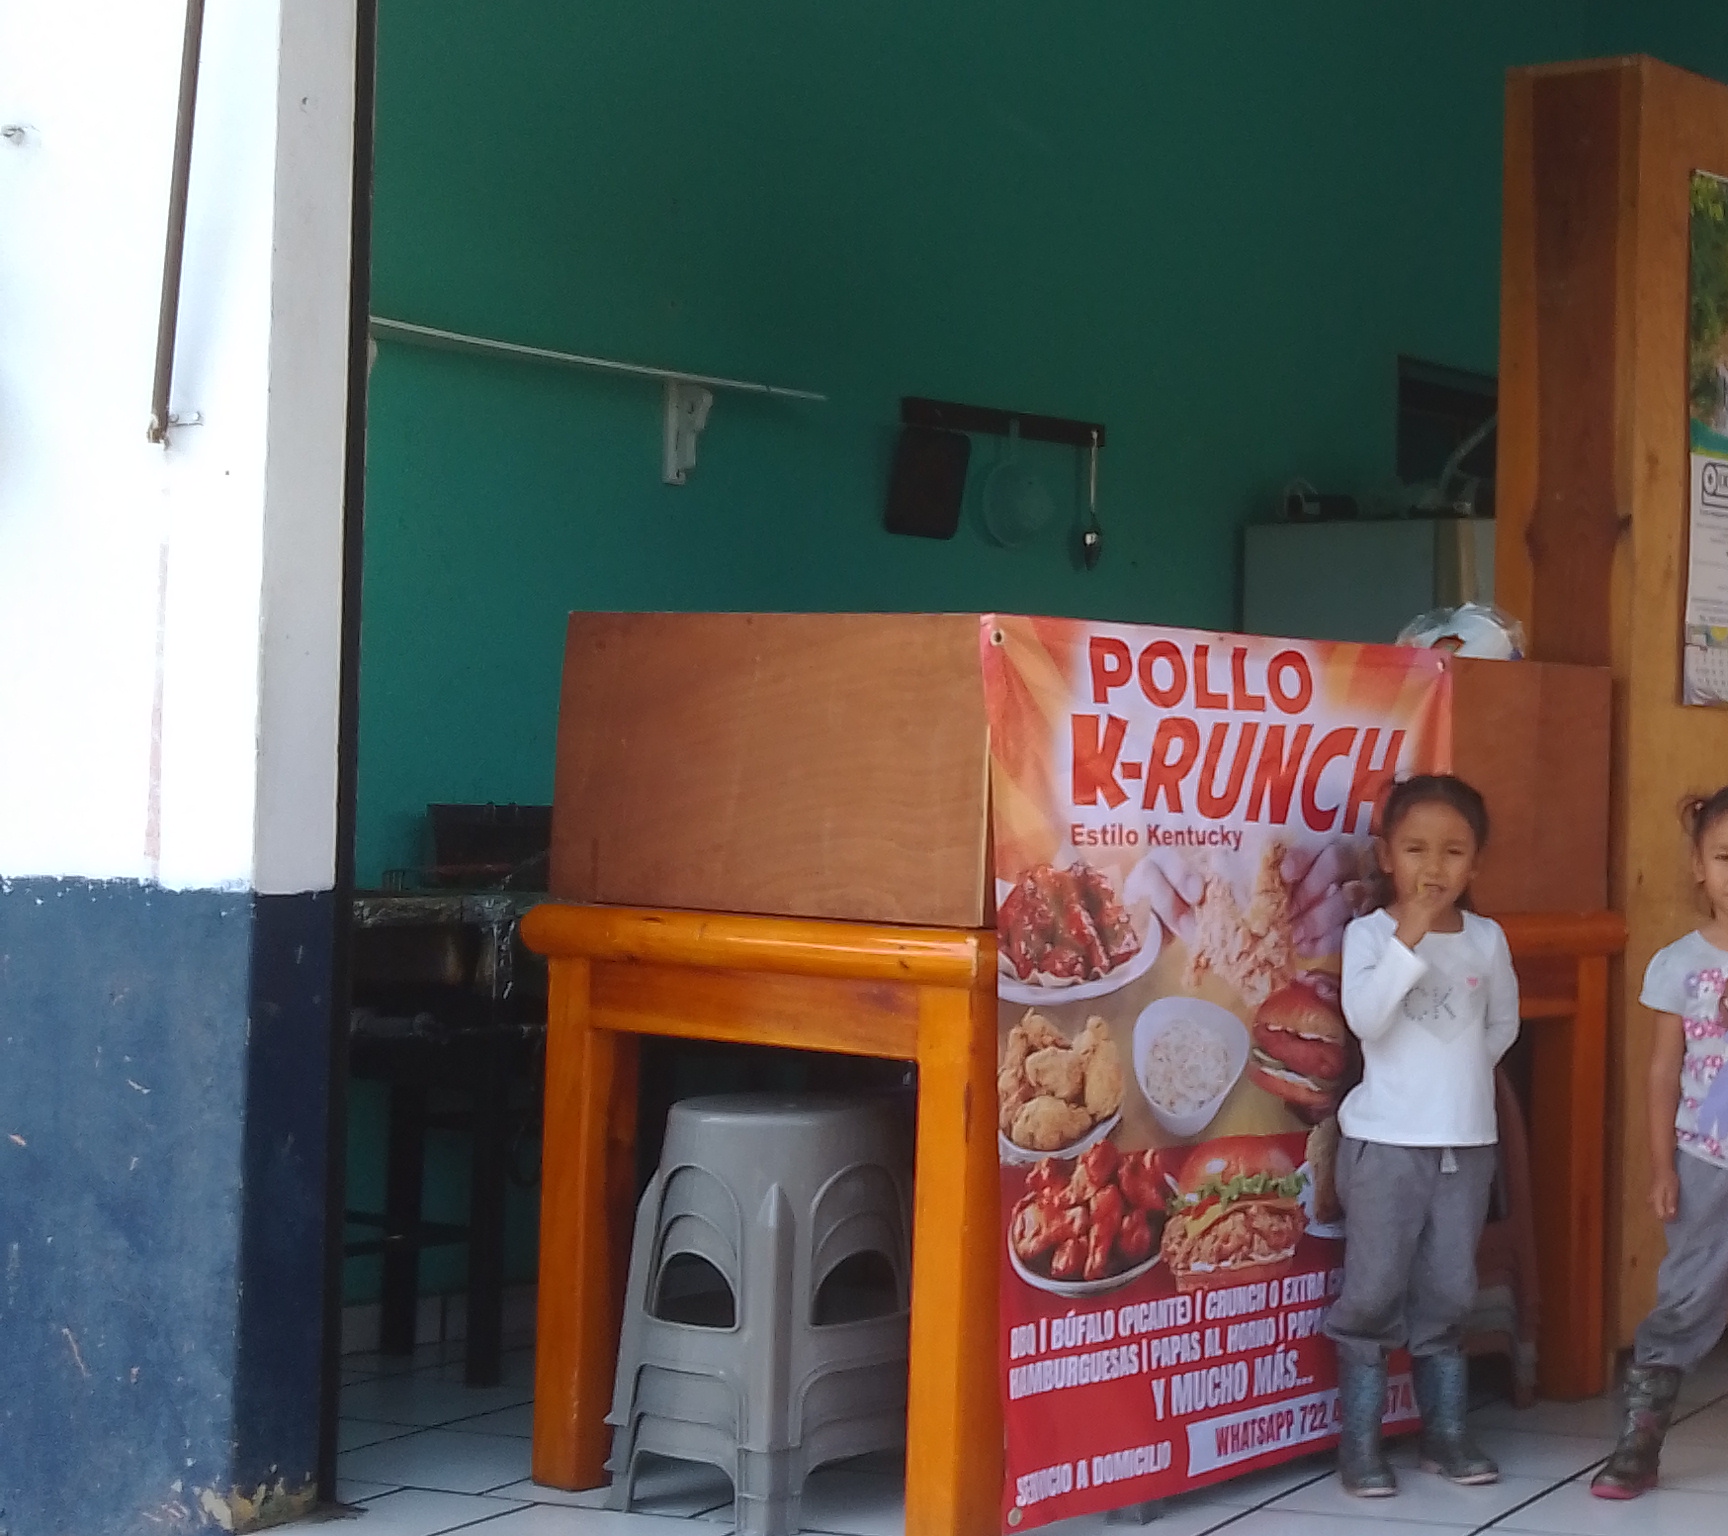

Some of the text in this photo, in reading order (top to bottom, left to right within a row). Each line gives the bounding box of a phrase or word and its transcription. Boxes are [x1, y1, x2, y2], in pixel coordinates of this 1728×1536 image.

[1088, 635, 1313, 715] POLLO
[1071, 713, 1406, 838] K-RUNCH
[1070, 823, 1243, 852] Estilo Kentucky
[1051, 1309, 1115, 1350] BÚFALO
[1118, 1294, 1192, 1338] (PICANTE)
[1205, 1282, 1268, 1320] CRUNCH
[1281, 1271, 1326, 1306] EXTRA
[1009, 1343, 1139, 1400] HAMBURGUESAS
[1151, 1330, 1201, 1370] PAPAS
[1204, 1327, 1224, 1358] AL
[1226, 1316, 1276, 1354] HORNO
[1287, 1306, 1326, 1341] PAPA
[1151, 1378, 1166, 1421] Y
[1171, 1360, 1249, 1417] MUCHO
[1076, 1459, 1089, 1490] A
[1092, 1440, 1172, 1487] DOMICILIO
[1215, 1408, 1294, 1458] WHATSAPP
[1300, 1401, 1328, 1435] 722
